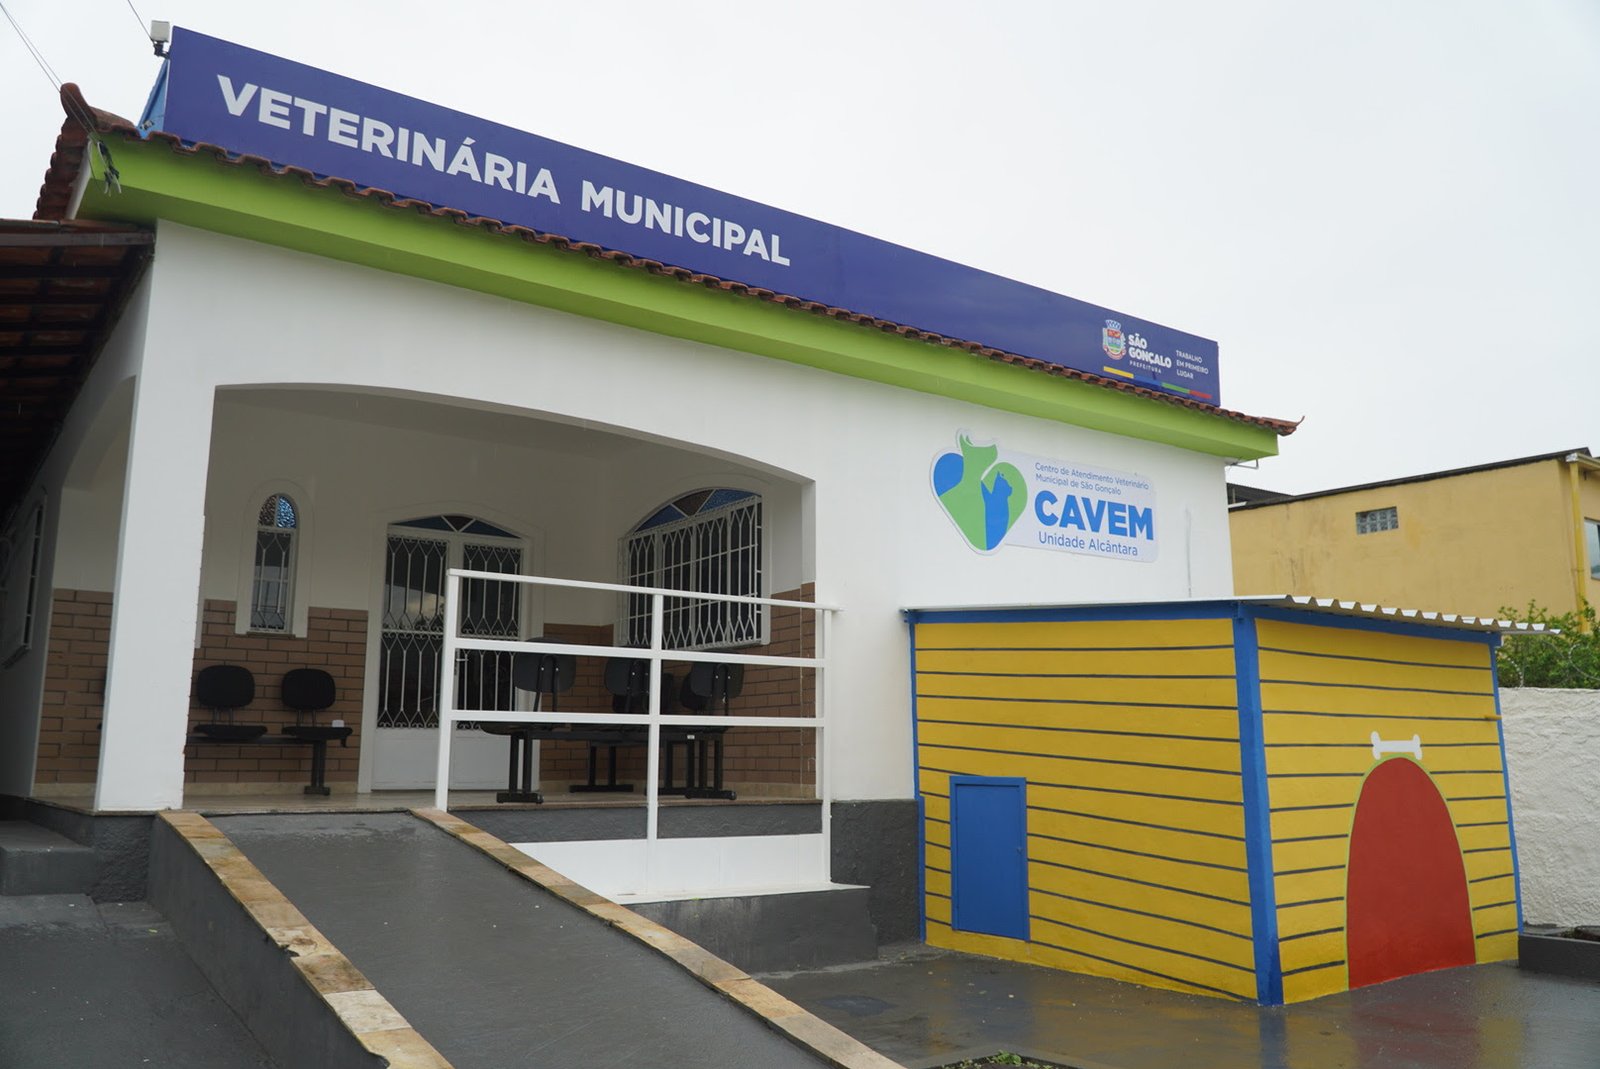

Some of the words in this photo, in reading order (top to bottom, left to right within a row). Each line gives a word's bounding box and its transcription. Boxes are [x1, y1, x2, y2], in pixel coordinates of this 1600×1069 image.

[217, 75, 560, 204] VETERINÁRIA
[581, 181, 790, 266] MUNICIPAL
[1128, 333, 1148, 349] SÃO
[1128, 348, 1172, 368] GONÇALO
[1175, 350, 1202, 363] TRABALHO
[1129, 361, 1162, 374] PREFEITURA
[1176, 360, 1185, 368] EM
[1185, 362, 1209, 375] PRIMEIRO
[1176, 370, 1194, 380] LUGAR
[1035, 462, 1059, 474] Centro
[1060, 466, 1070, 476] de
[1071, 468, 1114, 483] Atendimento
[1115, 476, 1149, 490] Veterinário
[1036, 474, 1069, 487] Municipal
[1070, 479, 1080, 488] de
[1080, 480, 1094, 491] São
[1094, 484, 1121, 496] Gonçalo
[1034, 490, 1154, 540] CAVEM
[1038, 531, 1085, 550] Unidade
[1088, 538, 1138, 556] Alcântara
